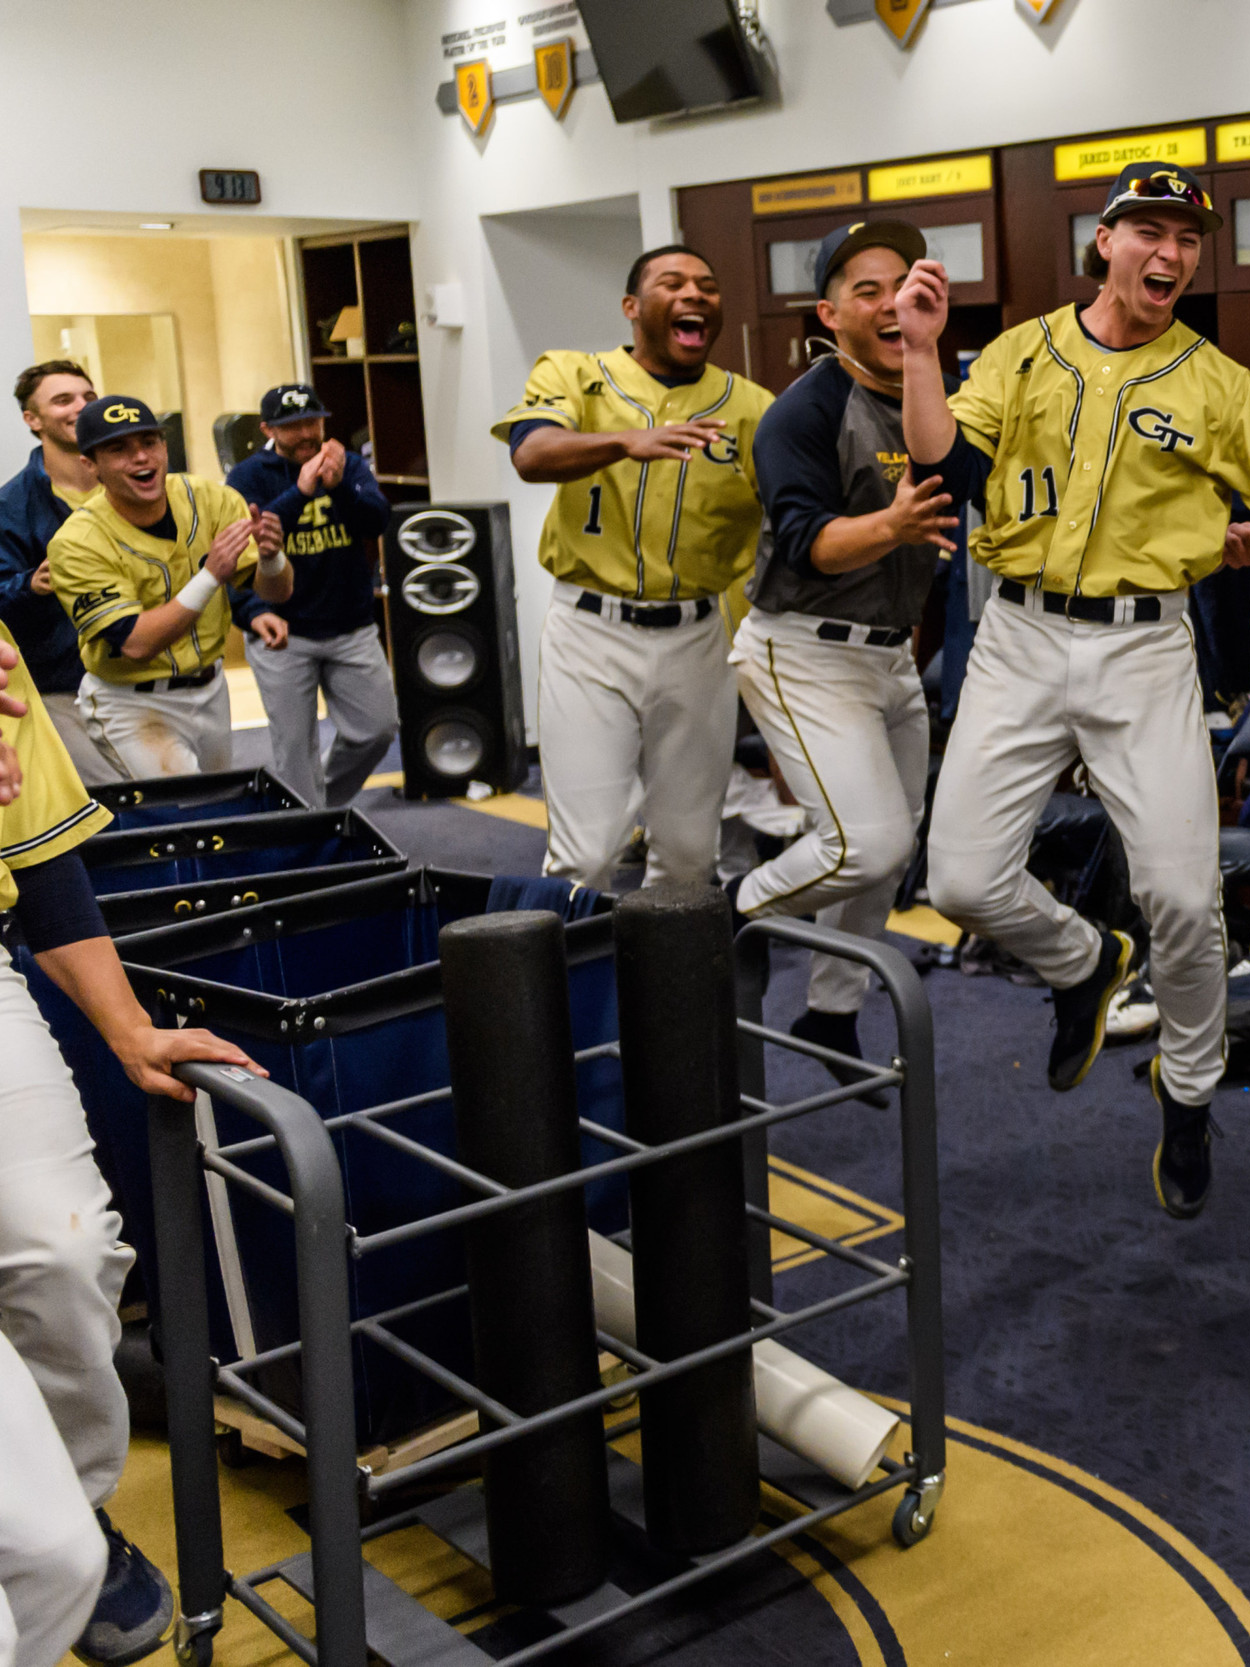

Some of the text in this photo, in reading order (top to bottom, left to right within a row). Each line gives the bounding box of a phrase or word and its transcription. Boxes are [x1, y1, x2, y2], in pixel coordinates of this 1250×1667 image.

[103, 403, 141, 423] GT
[1127, 406, 1195, 453] GT
[583, 485, 602, 536] 1
[1018, 466, 1059, 523] 11
[283, 523, 353, 556] ASEBALL
